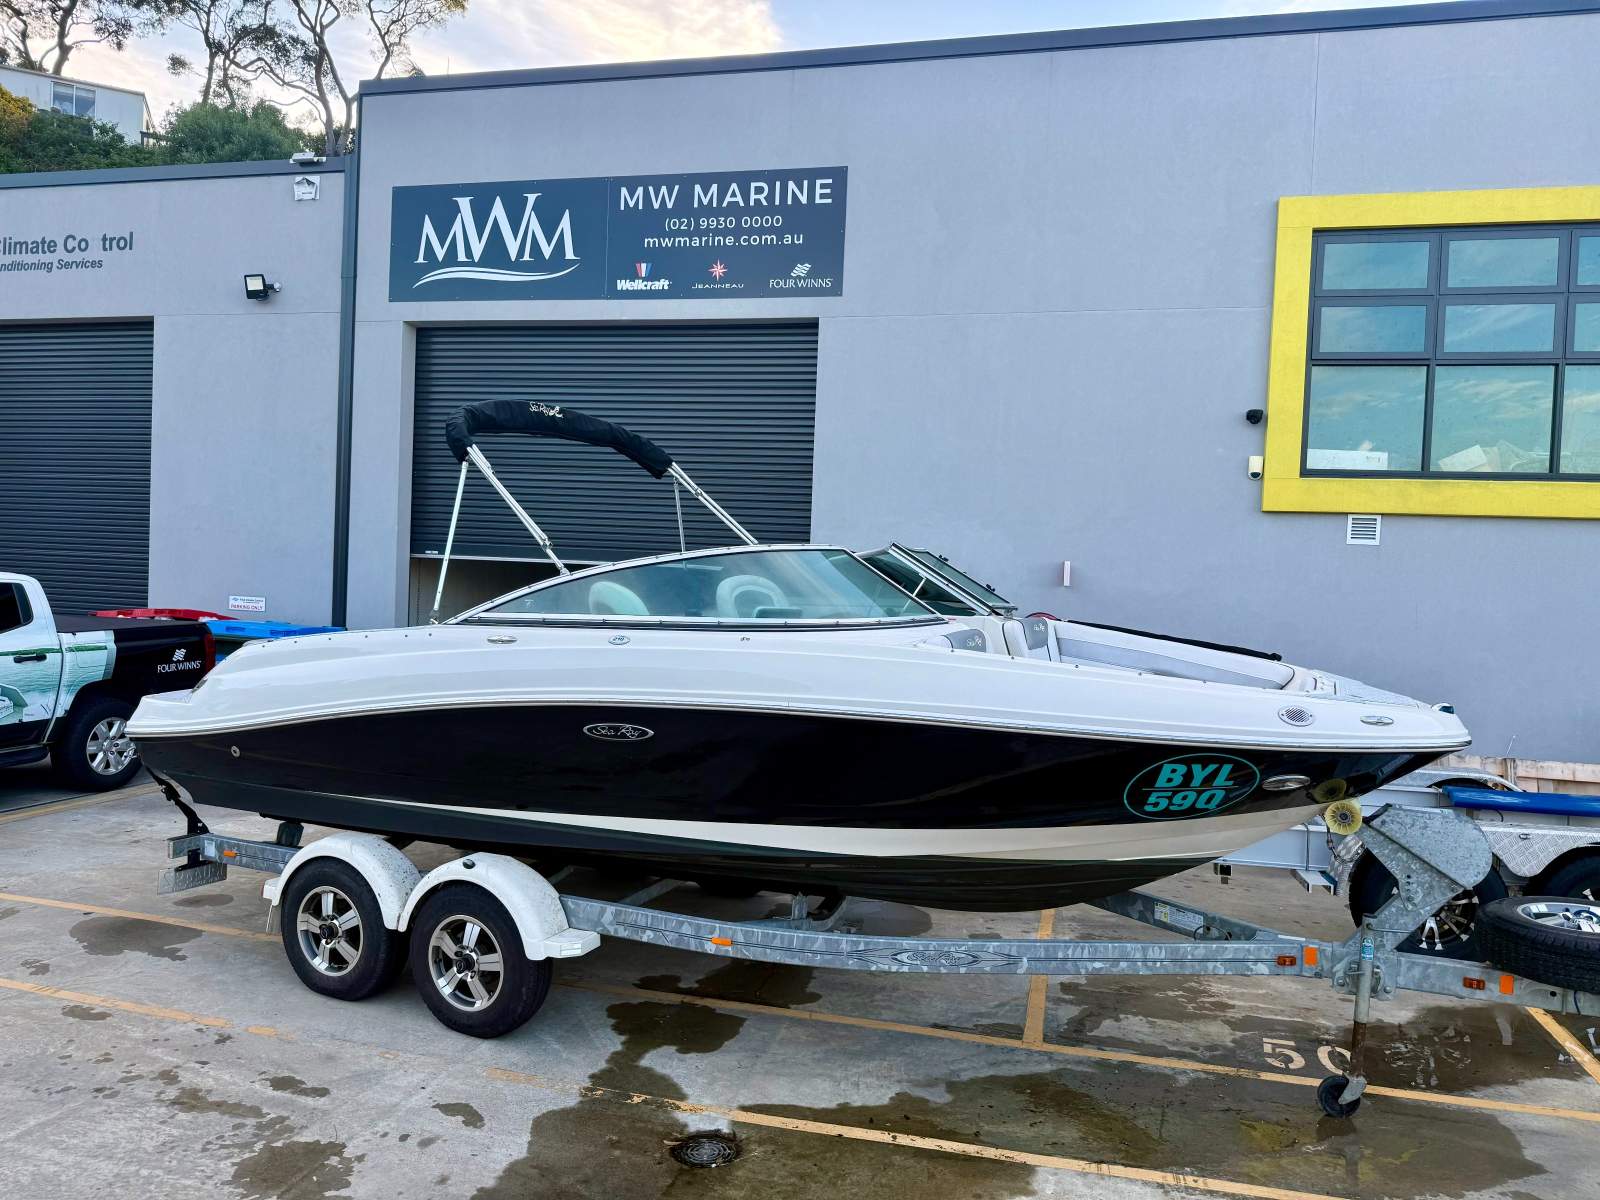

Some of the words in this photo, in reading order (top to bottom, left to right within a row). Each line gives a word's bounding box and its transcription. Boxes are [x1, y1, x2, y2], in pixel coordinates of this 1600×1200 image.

[619, 184, 680, 211] MW
[693, 178, 833, 208] MARINE
[413, 192, 581, 263] MWM
[665, 217, 695, 232] (02)
[699, 217, 736, 230] 9930
[741, 215, 783, 229] 0000
[0, 236, 58, 256] limate
[644, 233, 804, 249] mwmarine.com.au
[56, 258, 104, 271] Services
[616, 279, 670, 291] Wellcraft
[769, 279, 796, 289] FOUR
[796, 278, 832, 288] WINNS
[157, 663, 177, 673] FOUR
[177, 660, 201, 671] WINNS
[1154, 763, 1234, 788] BYL
